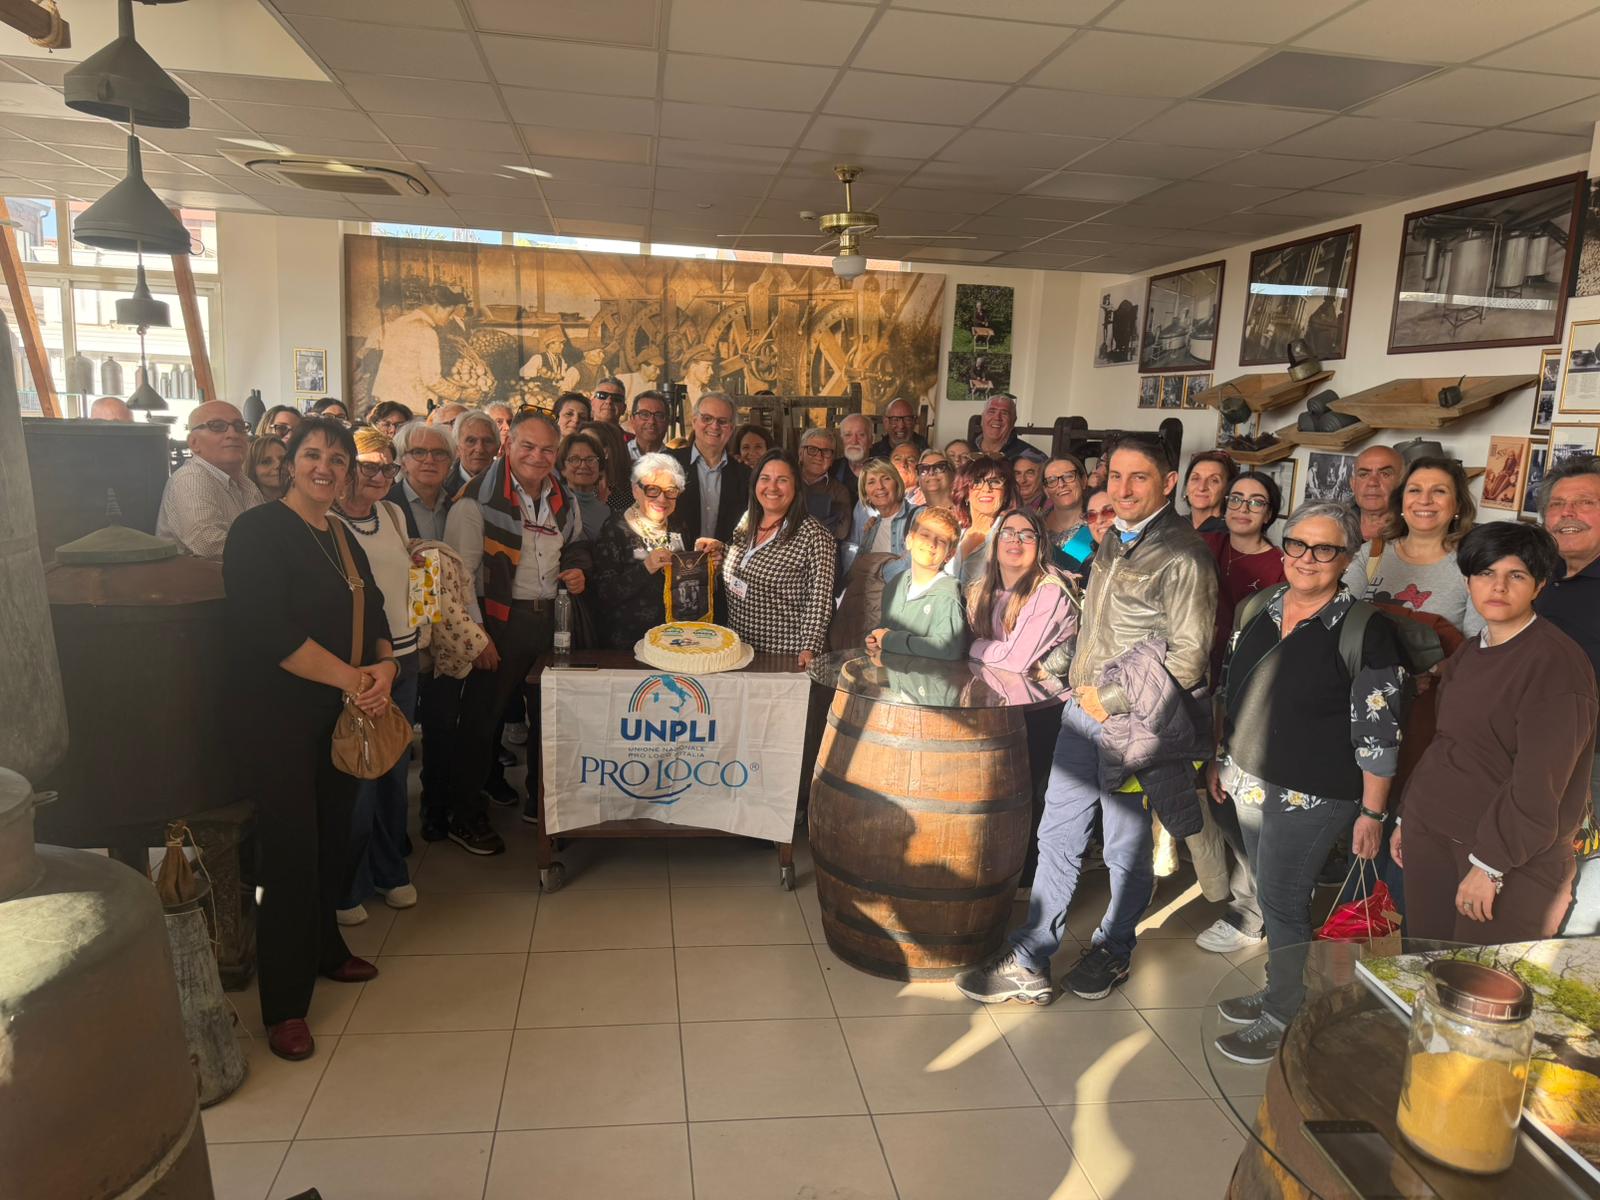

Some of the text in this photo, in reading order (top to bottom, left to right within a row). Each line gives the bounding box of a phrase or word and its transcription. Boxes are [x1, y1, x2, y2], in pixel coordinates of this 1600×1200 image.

[620, 718, 716, 742] UNPLI
[580, 756, 749, 791] PRO LOCO
